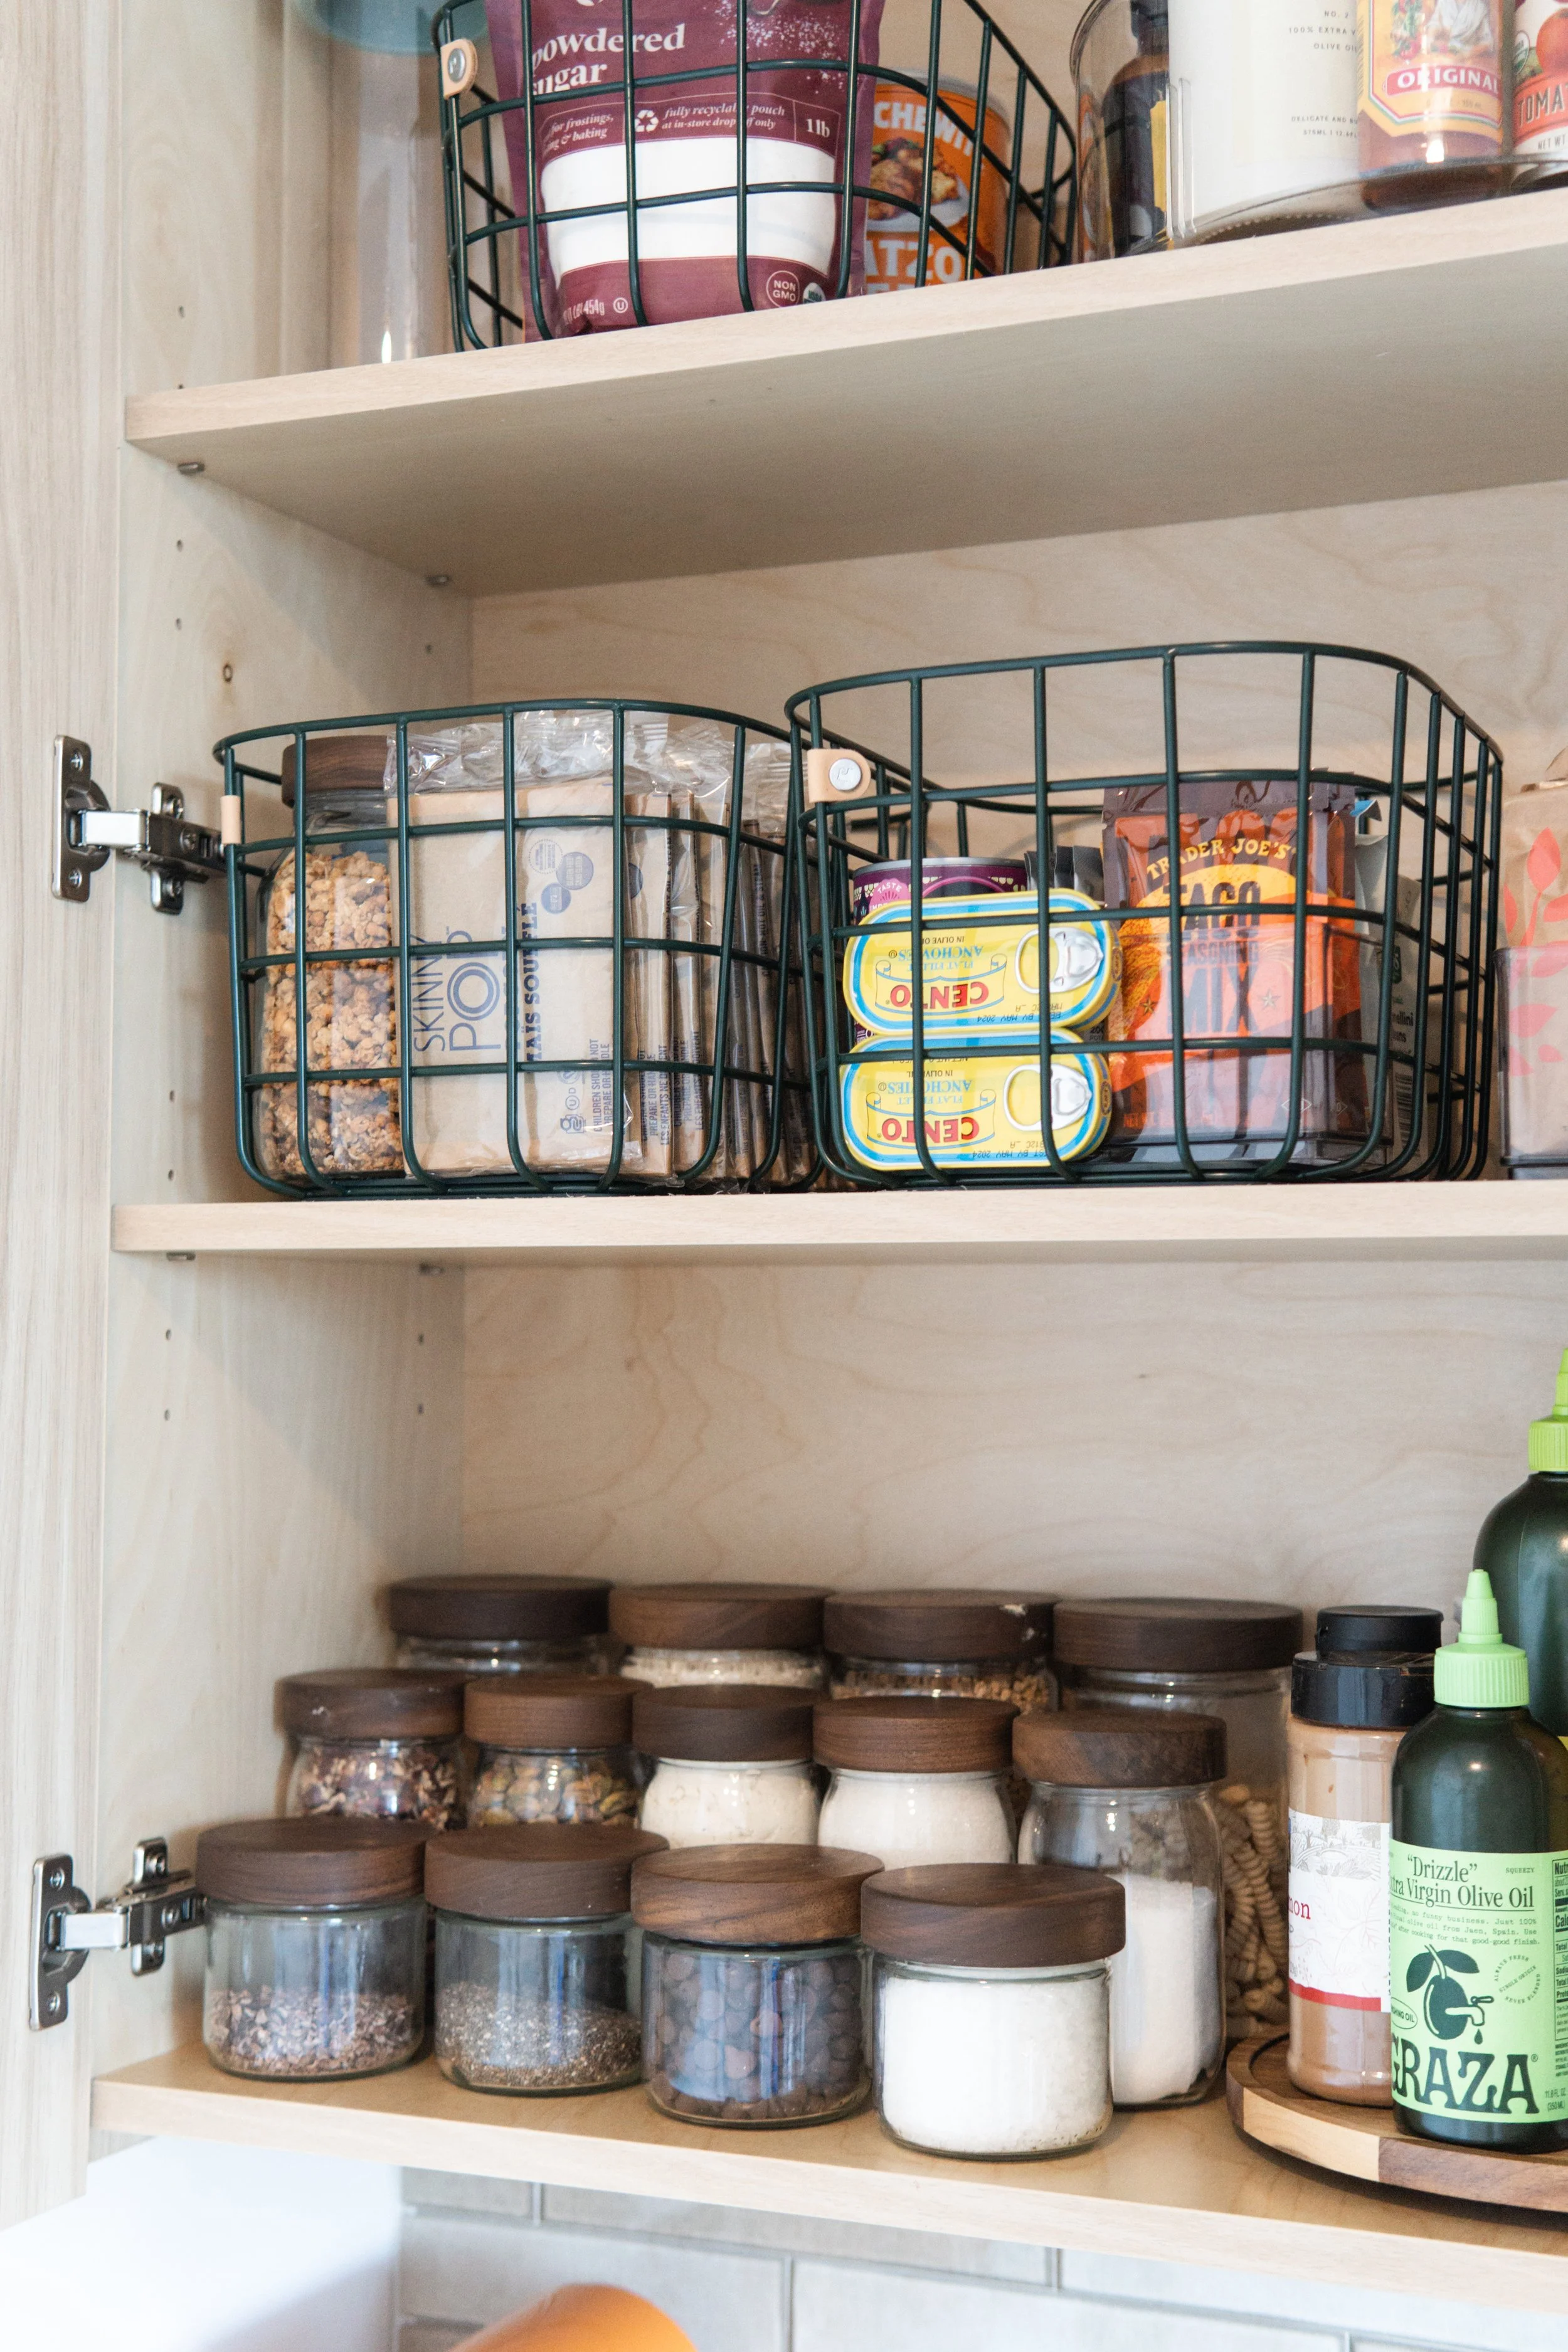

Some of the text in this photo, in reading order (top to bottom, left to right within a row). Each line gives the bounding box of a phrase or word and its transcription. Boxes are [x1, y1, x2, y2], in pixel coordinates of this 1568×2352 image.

[1318, 26, 1347, 34] EXTRA
[664, 103, 785, 120] fully recycla pouch
[566, 114, 614, 130] frostings,
[662, 119, 672, 129] at
[674, 118, 711, 128] in-store
[755, 118, 776, 130] only
[572, 128, 608, 141] baking
[1538, 134, 1565, 150] NET WT
[864, 239, 962, 283] ATZO
[773, 280, 796, 291] NON
[773, 290, 796, 302] GMO
[583, 299, 605, 316] 454g
[1231, 837, 1292, 860] JOE'S
[877, 882, 903, 894] TASTE
[931, 936, 955, 945] OLIVE
[898, 945, 984, 961] ANCHOVES
[1167, 942, 1259, 966] ASONING
[907, 961, 945, 972] FILLT
[446, 930, 501, 1052] POP
[890, 981, 989, 1009] CENO
[977, 1014, 996, 1023] 2024
[600, 1043, 610, 1076] HDLE
[589, 1039, 603, 1132] CHILDREN SHOD NOT
[601, 1077, 612, 1089] OR
[887, 1079, 972, 1094] ANCHOIES
[649, 1101, 658, 1136] PREPARE
[882, 1117, 979, 1143] CENTO
[972, 1150, 992, 1158] 2024
[1407, 1877, 1451, 1907] Virgin
[1457, 1885, 1503, 1908] Olive
[1508, 1886, 1535, 1908] Oil
[1407, 1918, 1424, 1927] olive
[1443, 1924, 1460, 1932] from
[1422, 1912, 1443, 1921] funny
[1447, 1915, 1489, 1924] business.
[1411, 1930, 1434, 1940] cooking
[1555, 1942, 1567, 1951] Total
[1405, 2013, 1415, 2023] OIL
[1391, 2032, 1540, 2114] GRAZA
